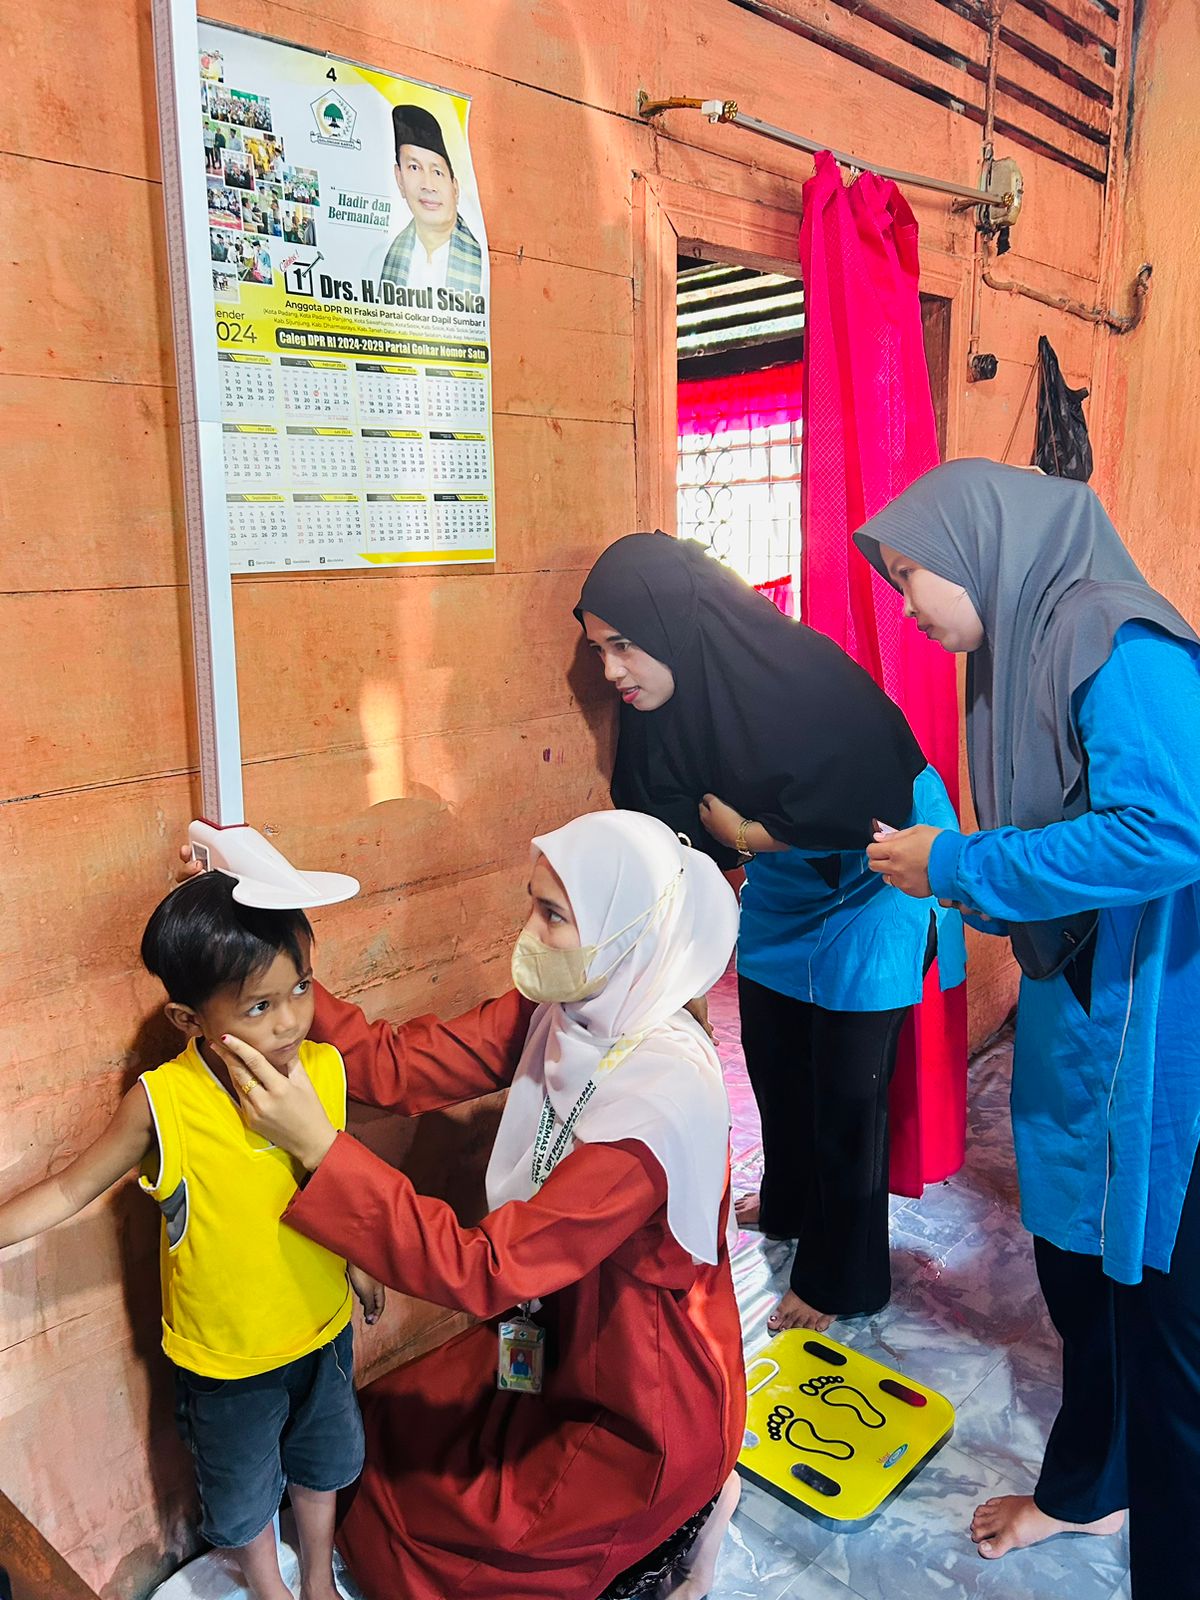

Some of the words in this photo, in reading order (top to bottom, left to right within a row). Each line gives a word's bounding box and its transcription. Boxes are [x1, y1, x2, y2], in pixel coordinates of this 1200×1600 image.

[326, 67, 337, 82] 4
[339, 194, 369, 209] Hadir
[372, 199, 391, 212] dan
[294, 268, 302, 290] 1
[320, 274, 358, 302] Drs.
[361, 279, 379, 304] H.
[383, 282, 432, 309] Darul
[437, 288, 485, 314] Siska
[216, 311, 245, 320] ender
[286, 300, 322, 312] Anggota
[324, 305, 342, 314] DPR
[354, 308, 378, 317] Fraksi
[380, 310, 403, 320] Partai
[405, 313, 430, 322] Golkar
[432, 316, 451, 325] Dapil
[453, 318, 481, 327] Sumbar
[216, 321, 257, 343] 024
[280, 332, 306, 346] Caleg
[307, 334, 326, 347] DPR
[327, 336, 336, 348] RI
[338, 337, 384, 352] 2024-2029
[385, 342, 411, 354] Partai
[412, 344, 439, 356] Golkar
[440, 346, 466, 358] Nomor
[467, 348, 486, 359] Satu
[540, 1107, 556, 1151] SKESMAS
[544, 1154, 554, 1172] UPT
[552, 1107, 577, 1155] PUSKESMAS
[576, 1080, 594, 1107] TAPAN
[534, 1152, 545, 1184] TAPAN
